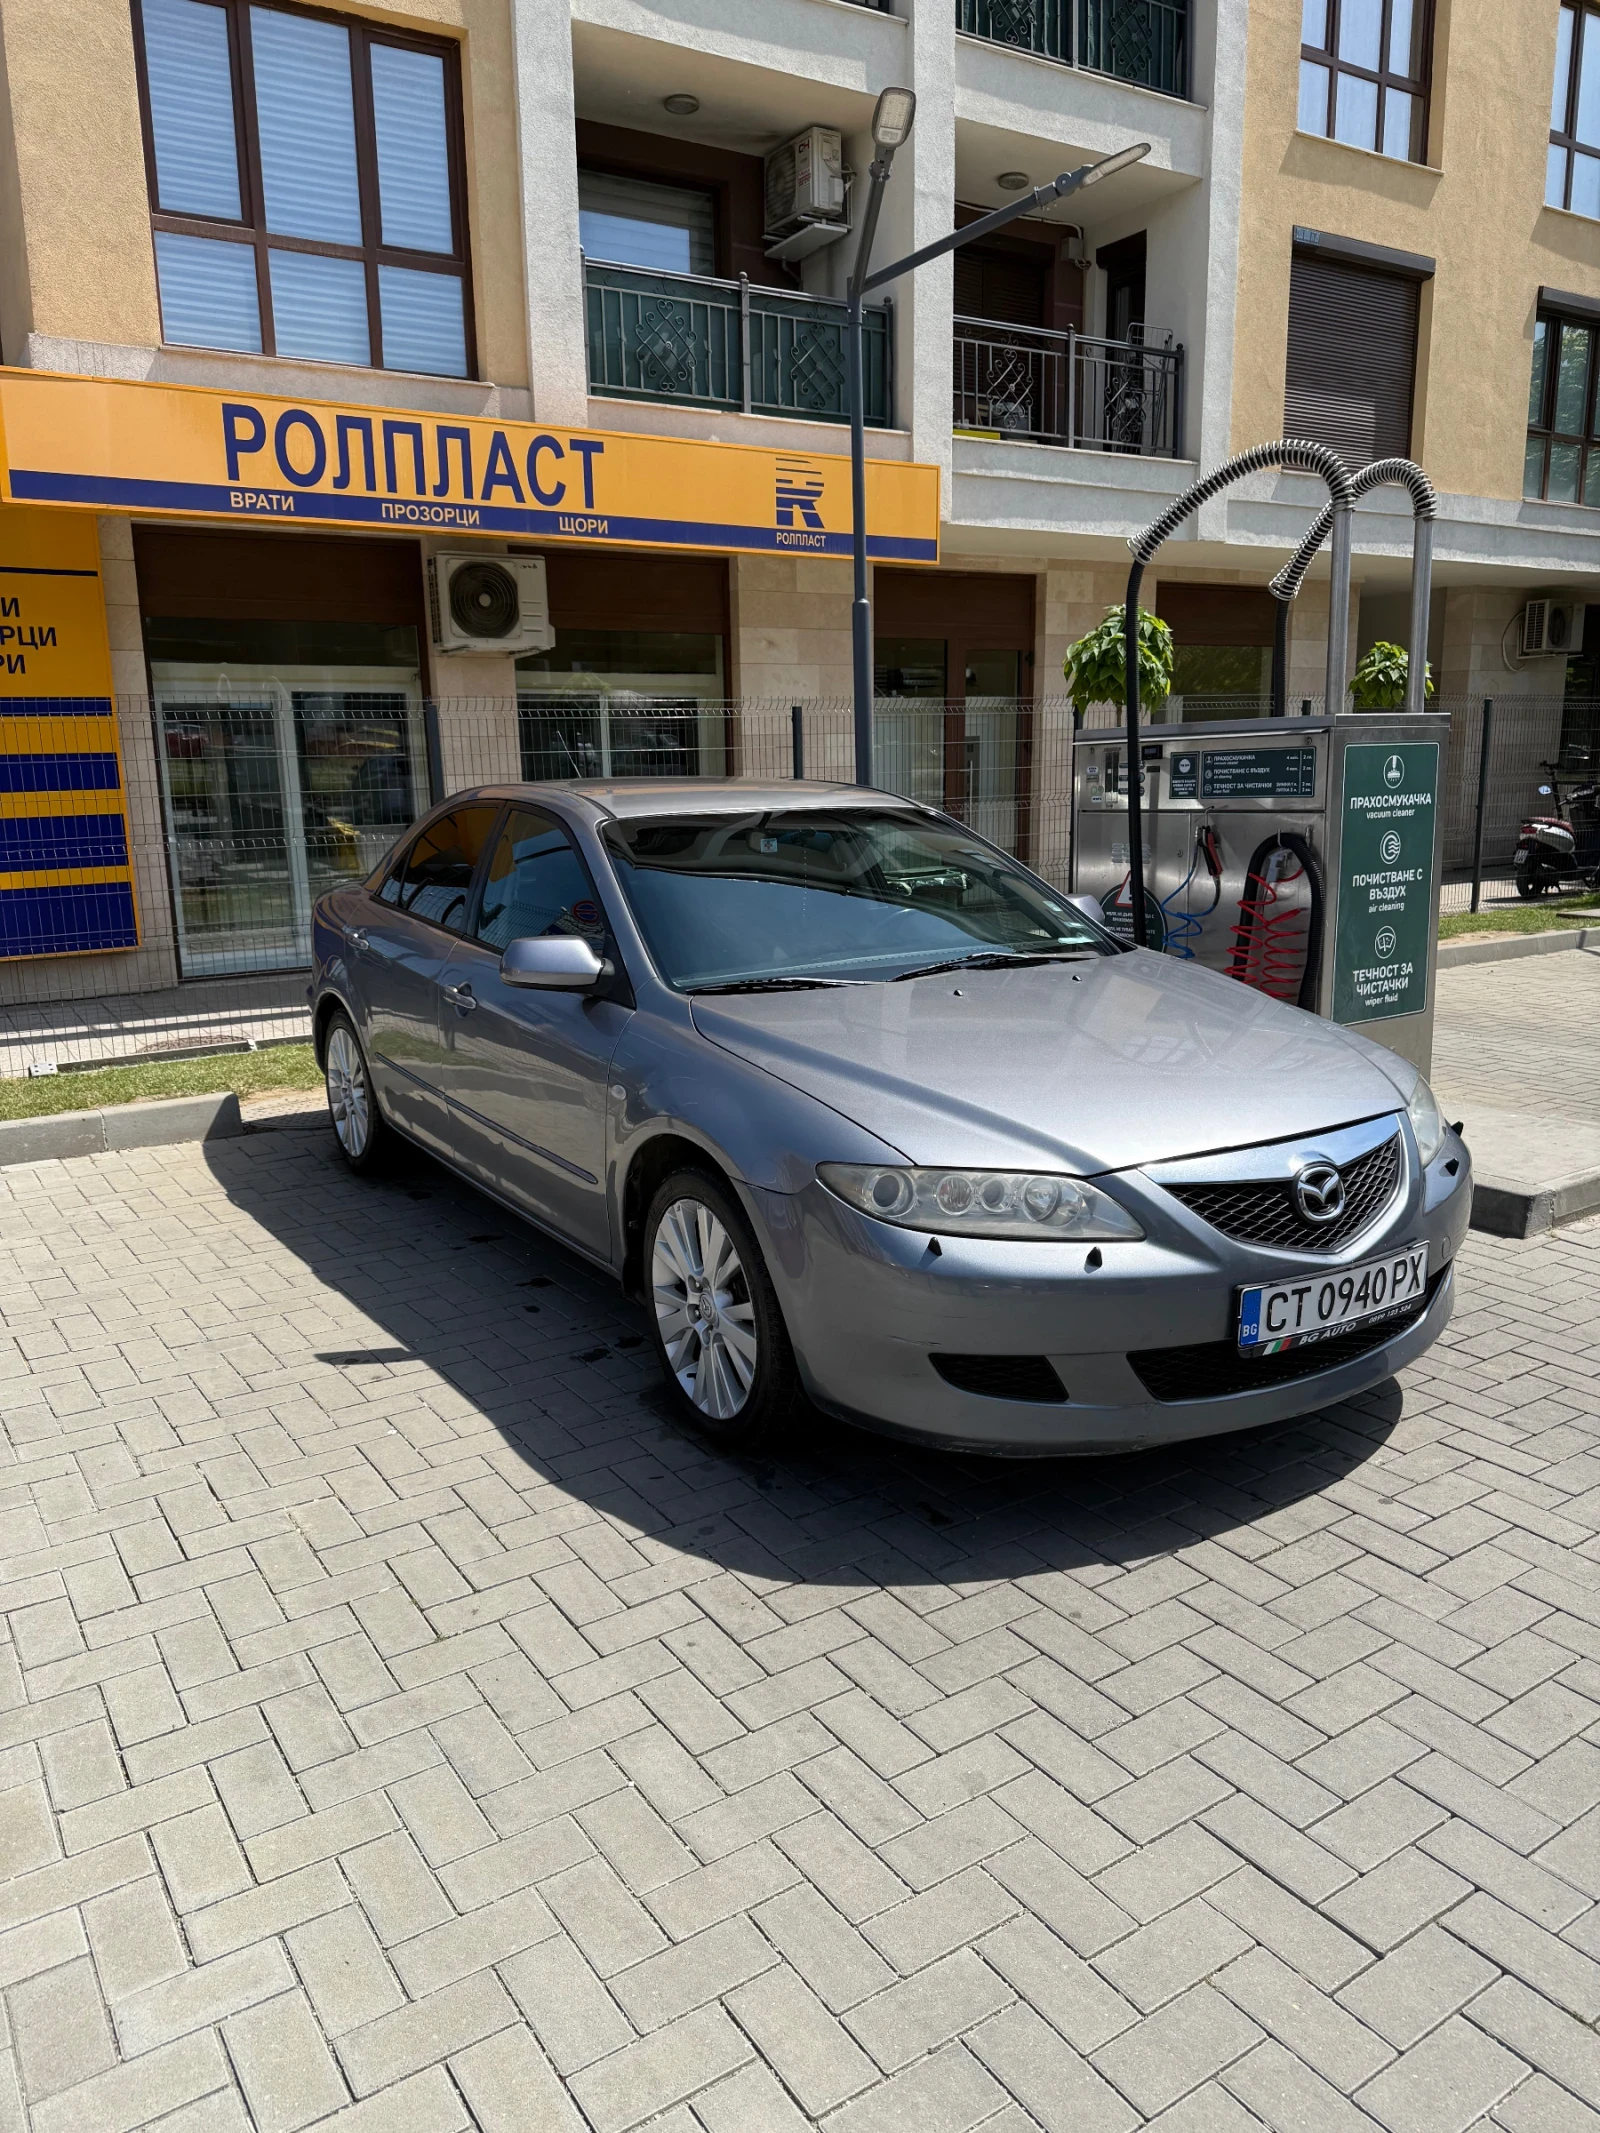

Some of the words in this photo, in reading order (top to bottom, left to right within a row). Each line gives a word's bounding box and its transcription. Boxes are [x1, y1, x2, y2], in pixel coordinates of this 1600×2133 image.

[221, 402, 604, 509] РОЛПЛАСТ
[229, 491, 295, 512] ВРАТИ
[381, 502, 480, 526] ПРОЗОРЦИ
[558, 516, 609, 535] ЩОРИ
[775, 531, 826, 548] РОЛПЛАСТ
[1350, 792, 1432, 810] ПРАХОСМУКАЧКА
[1366, 810, 1391, 819] vacuum
[1392, 808, 1415, 818] cleaner
[1352, 869, 1415, 887] ПОЧИСТВАНЕ
[1416, 868, 1423, 880] С
[1369, 885, 1406, 901] ВЪЗДУХ
[1368, 904, 1378, 913] air
[1378, 901, 1405, 912] cleaning
[1352, 963, 1400, 983] ТЕЧНОСТ
[1400, 962, 1414, 976] ЗА
[1356, 976, 1409, 996] ЧИСТАЧКИ
[1364, 996, 1384, 1007] wiper
[1384, 993, 1399, 1004] fluid
[1242, 1323, 1258, 1337] BG
[1298, 1333, 1319, 1346] BG
[1321, 1322, 1357, 1340] AUTO
